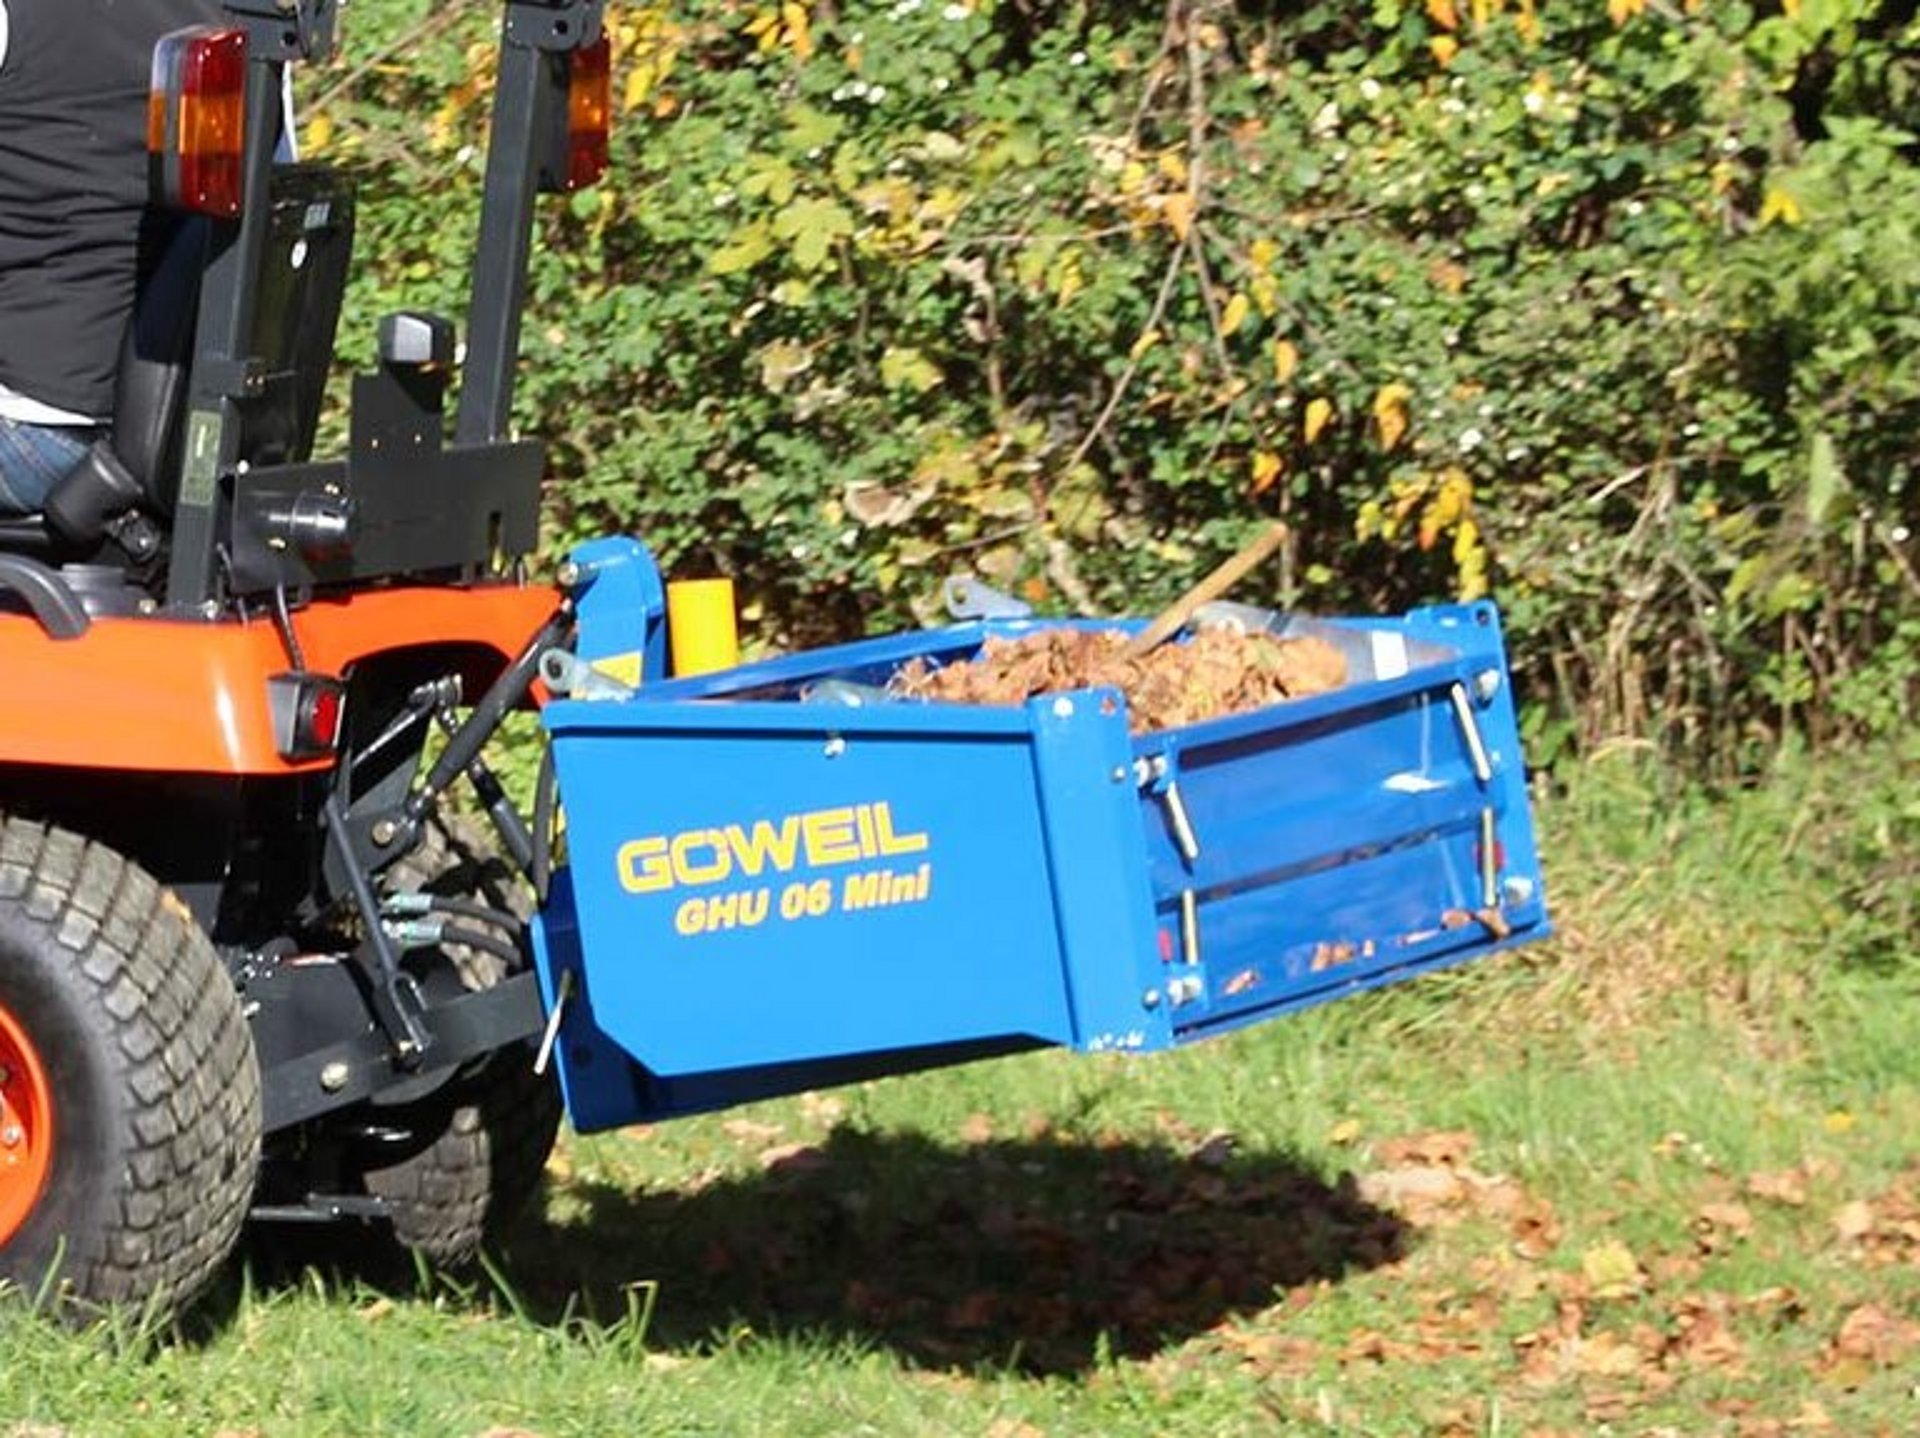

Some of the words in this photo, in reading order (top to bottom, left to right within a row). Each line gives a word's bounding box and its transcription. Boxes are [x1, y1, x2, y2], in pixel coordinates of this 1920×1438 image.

[675, 888, 770, 935] GHU
[780, 879, 832, 920] 06
[842, 864, 930, 910] Mini
